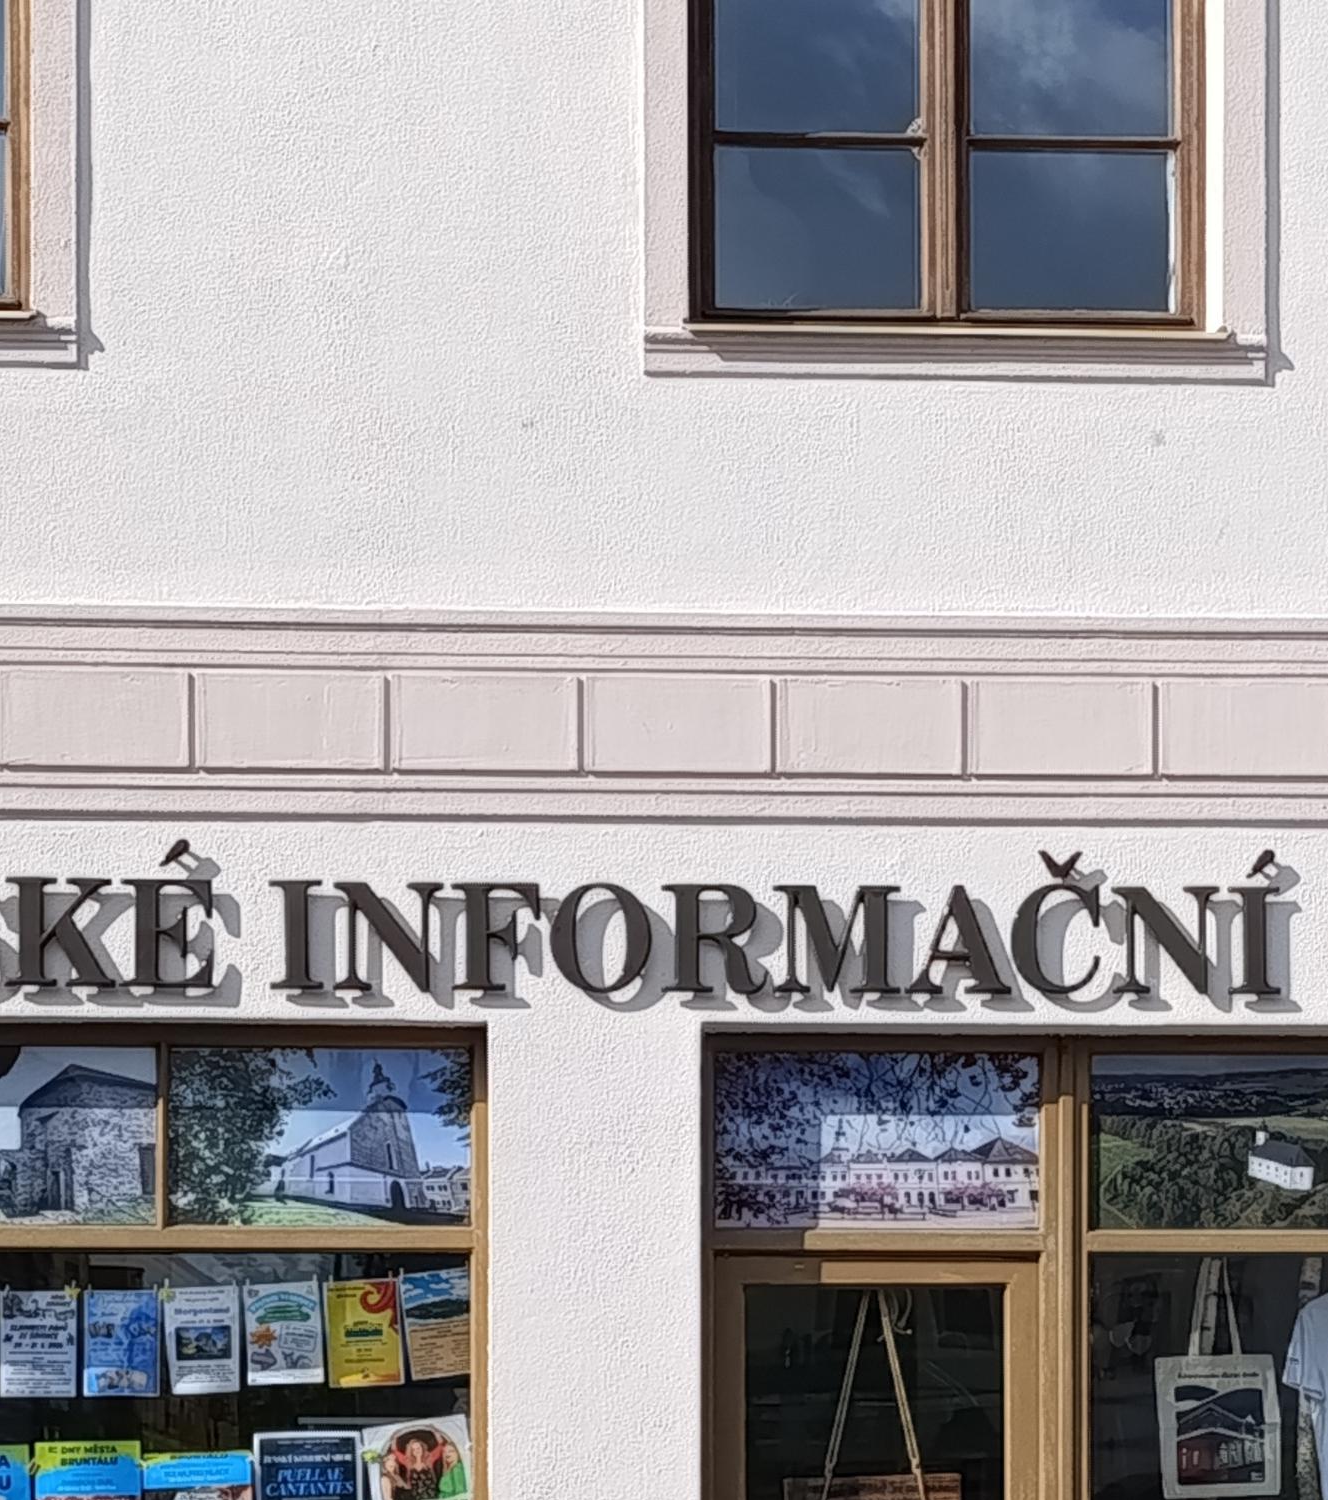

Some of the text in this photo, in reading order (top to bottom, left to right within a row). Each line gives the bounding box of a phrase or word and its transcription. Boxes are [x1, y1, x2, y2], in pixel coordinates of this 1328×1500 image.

[269, 849, 1281, 996] INFORMAČNÍ
[61, 1444, 117, 1454] DNY MĚSTA
[61, 1456, 119, 1466] BRUNTÁLU
[265, 1481, 355, 1497] CANTANTES
